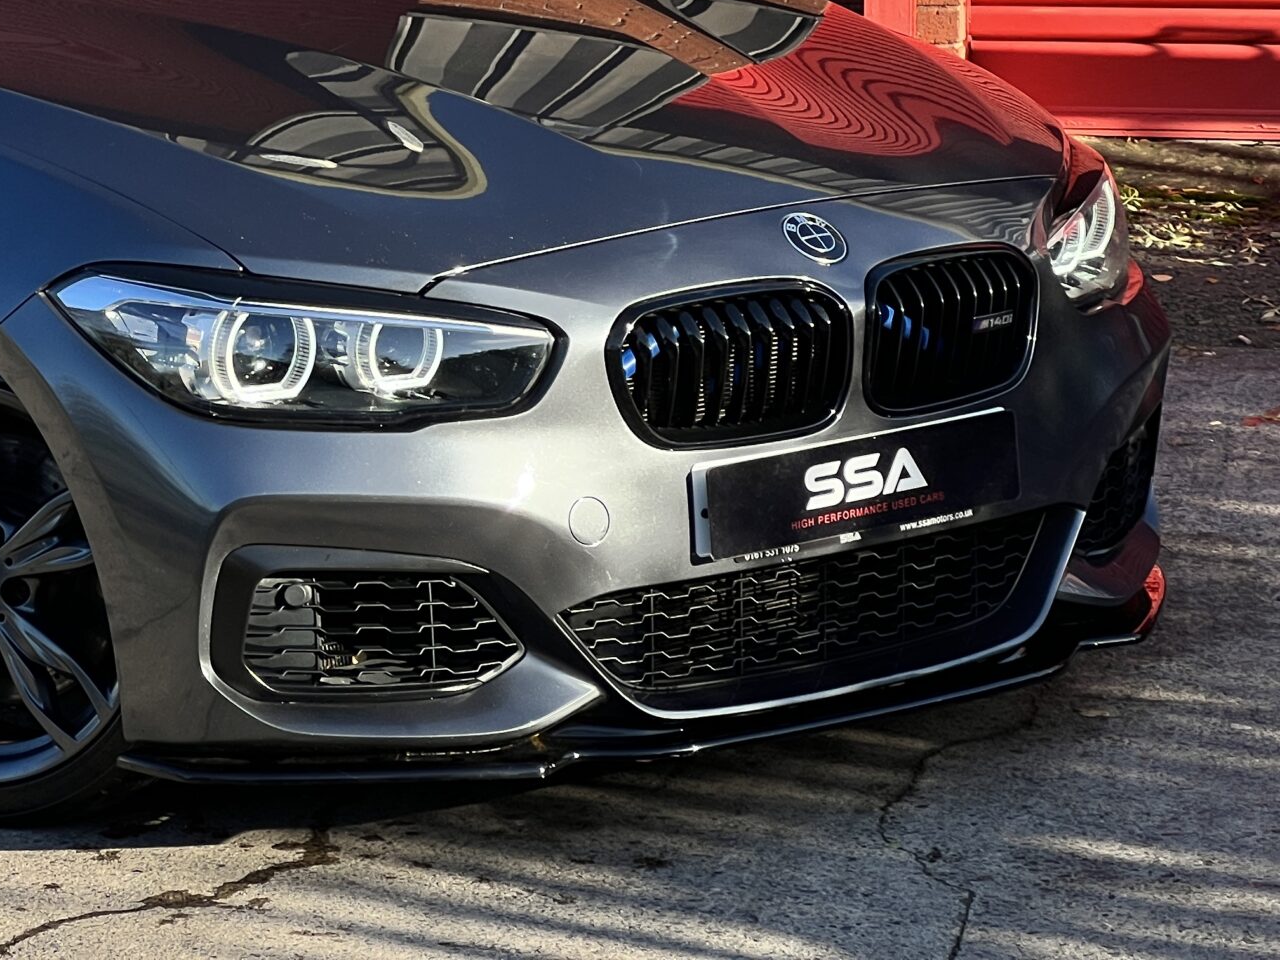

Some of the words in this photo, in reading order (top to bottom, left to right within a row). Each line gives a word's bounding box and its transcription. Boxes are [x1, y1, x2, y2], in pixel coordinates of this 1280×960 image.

[804, 447, 928, 511] SSA
[791, 516, 815, 531] HIGH
[817, 501, 889, 525] PERFORMANCE
[892, 496, 917, 510] USED
[920, 491, 945, 504] CARS
[900, 509, 974, 531] www.ssamotors.co.uk
